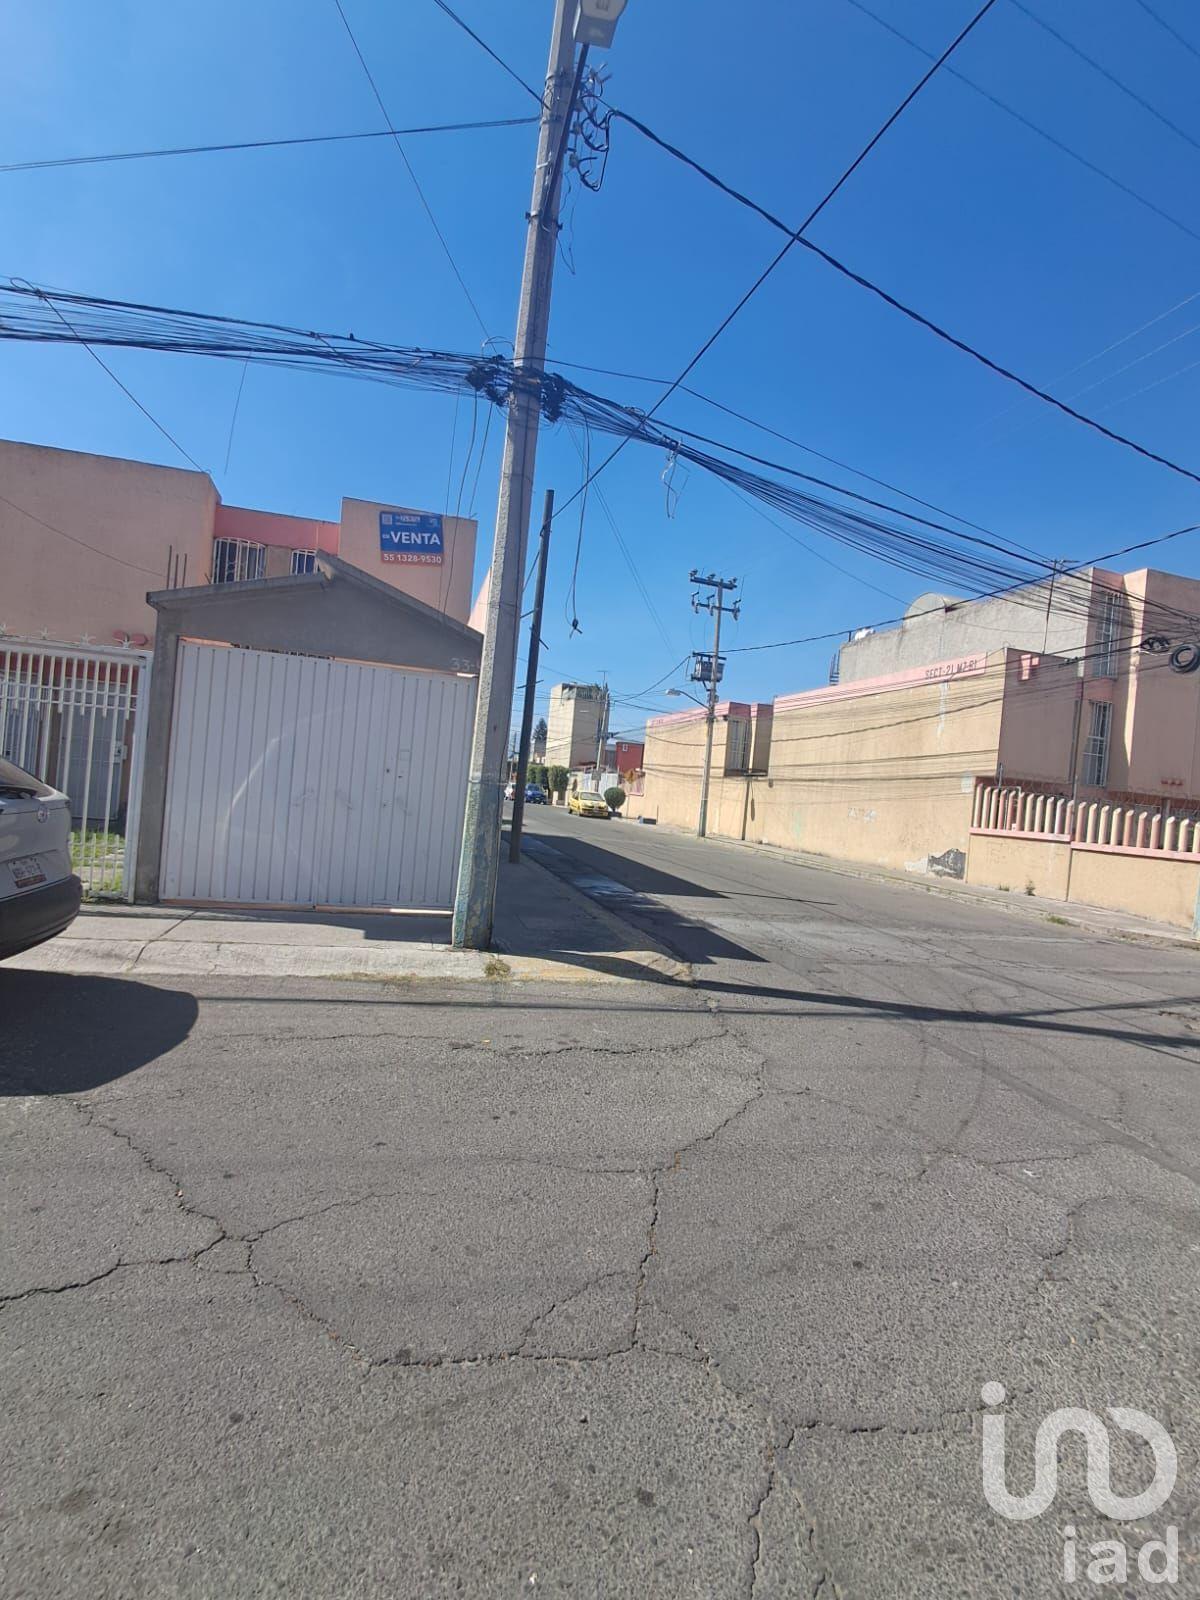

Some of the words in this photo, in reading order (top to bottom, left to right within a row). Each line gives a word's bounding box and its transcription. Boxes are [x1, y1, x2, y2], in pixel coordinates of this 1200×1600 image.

[390, 530, 441, 545] VENTA
[383, 553, 395, 561] 55
[396, 554, 442, 564] 1328-9530
